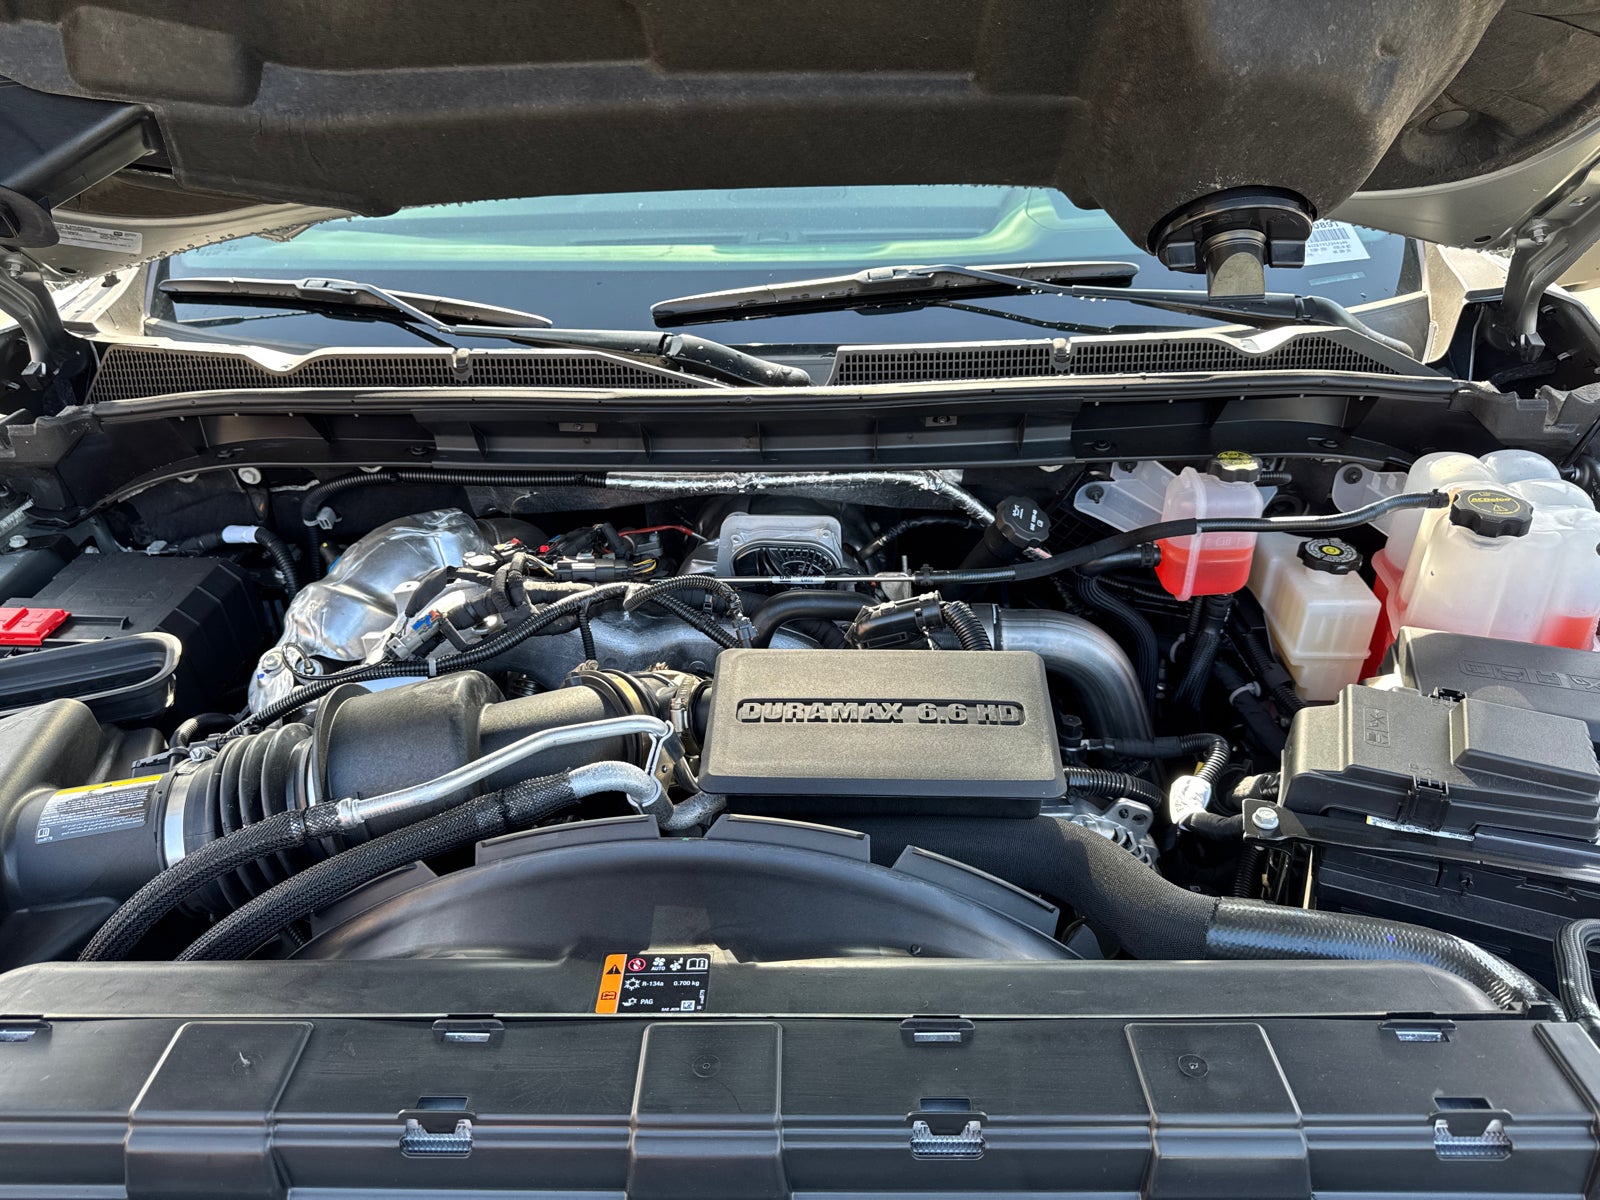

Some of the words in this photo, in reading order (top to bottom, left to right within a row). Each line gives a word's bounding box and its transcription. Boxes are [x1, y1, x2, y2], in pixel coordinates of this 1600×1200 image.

[739, 702, 903, 723] DURAMAX
[917, 703, 968, 722] 6.6
[976, 704, 1020, 723] HD
